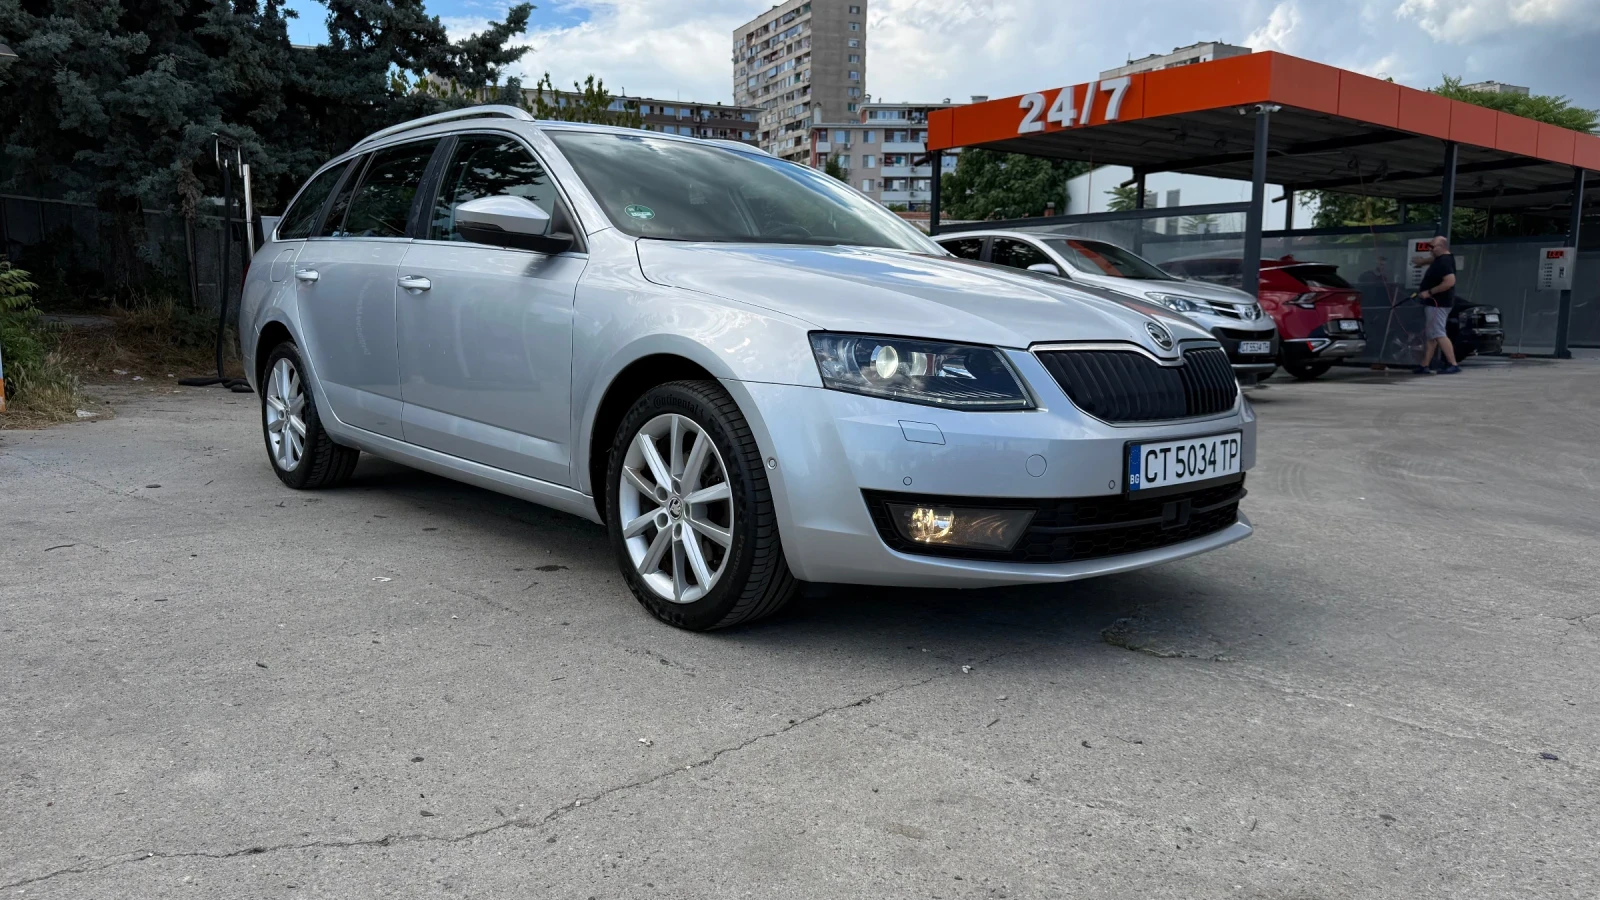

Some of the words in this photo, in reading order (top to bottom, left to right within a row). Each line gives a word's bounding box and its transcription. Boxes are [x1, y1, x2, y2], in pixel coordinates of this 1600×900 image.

[1017, 75, 1132, 134] 24/7
[653, 394, 699, 415] Continental
[1145, 447, 1171, 483] CT
[1175, 441, 1217, 479] 5034
[1220, 438, 1238, 471] TP
[1130, 473, 1140, 485] BG
